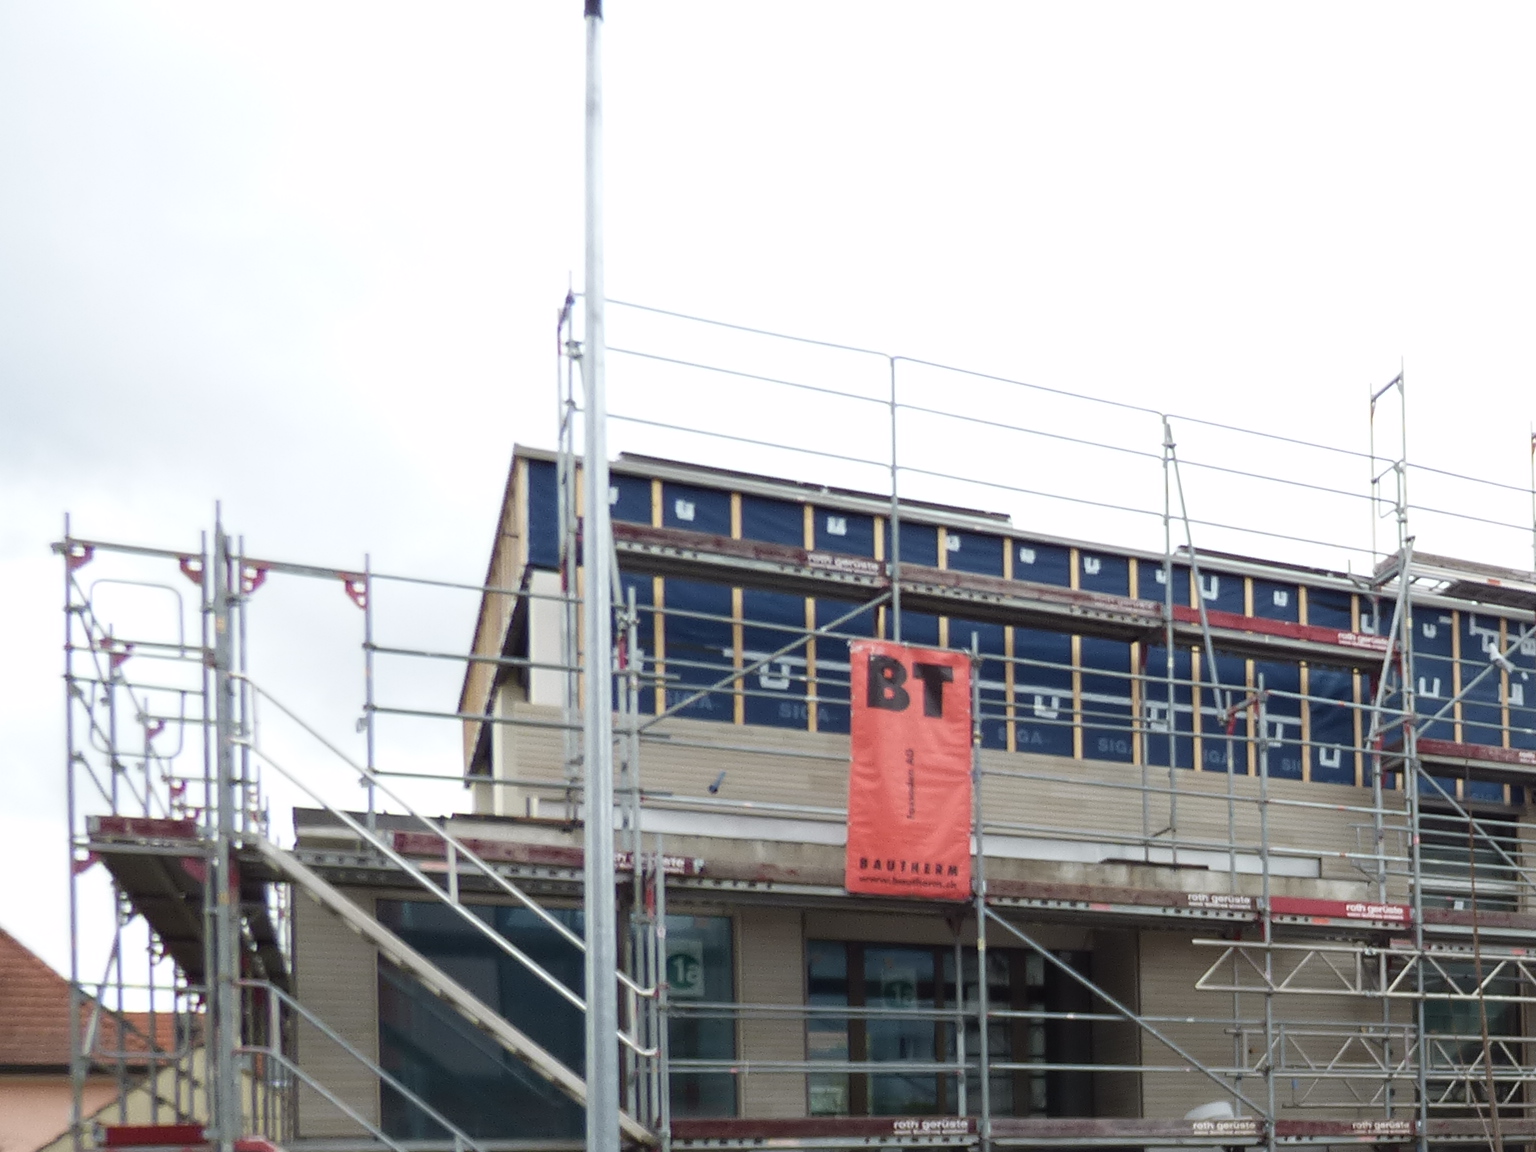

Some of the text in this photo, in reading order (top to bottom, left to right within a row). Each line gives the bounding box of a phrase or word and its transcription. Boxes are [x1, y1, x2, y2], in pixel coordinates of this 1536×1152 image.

[867, 655, 954, 719] BT
[859, 857, 958, 876] BAUTHERM
[893, 1119, 919, 1130] roth
[1193, 1121, 1215, 1130] roth
